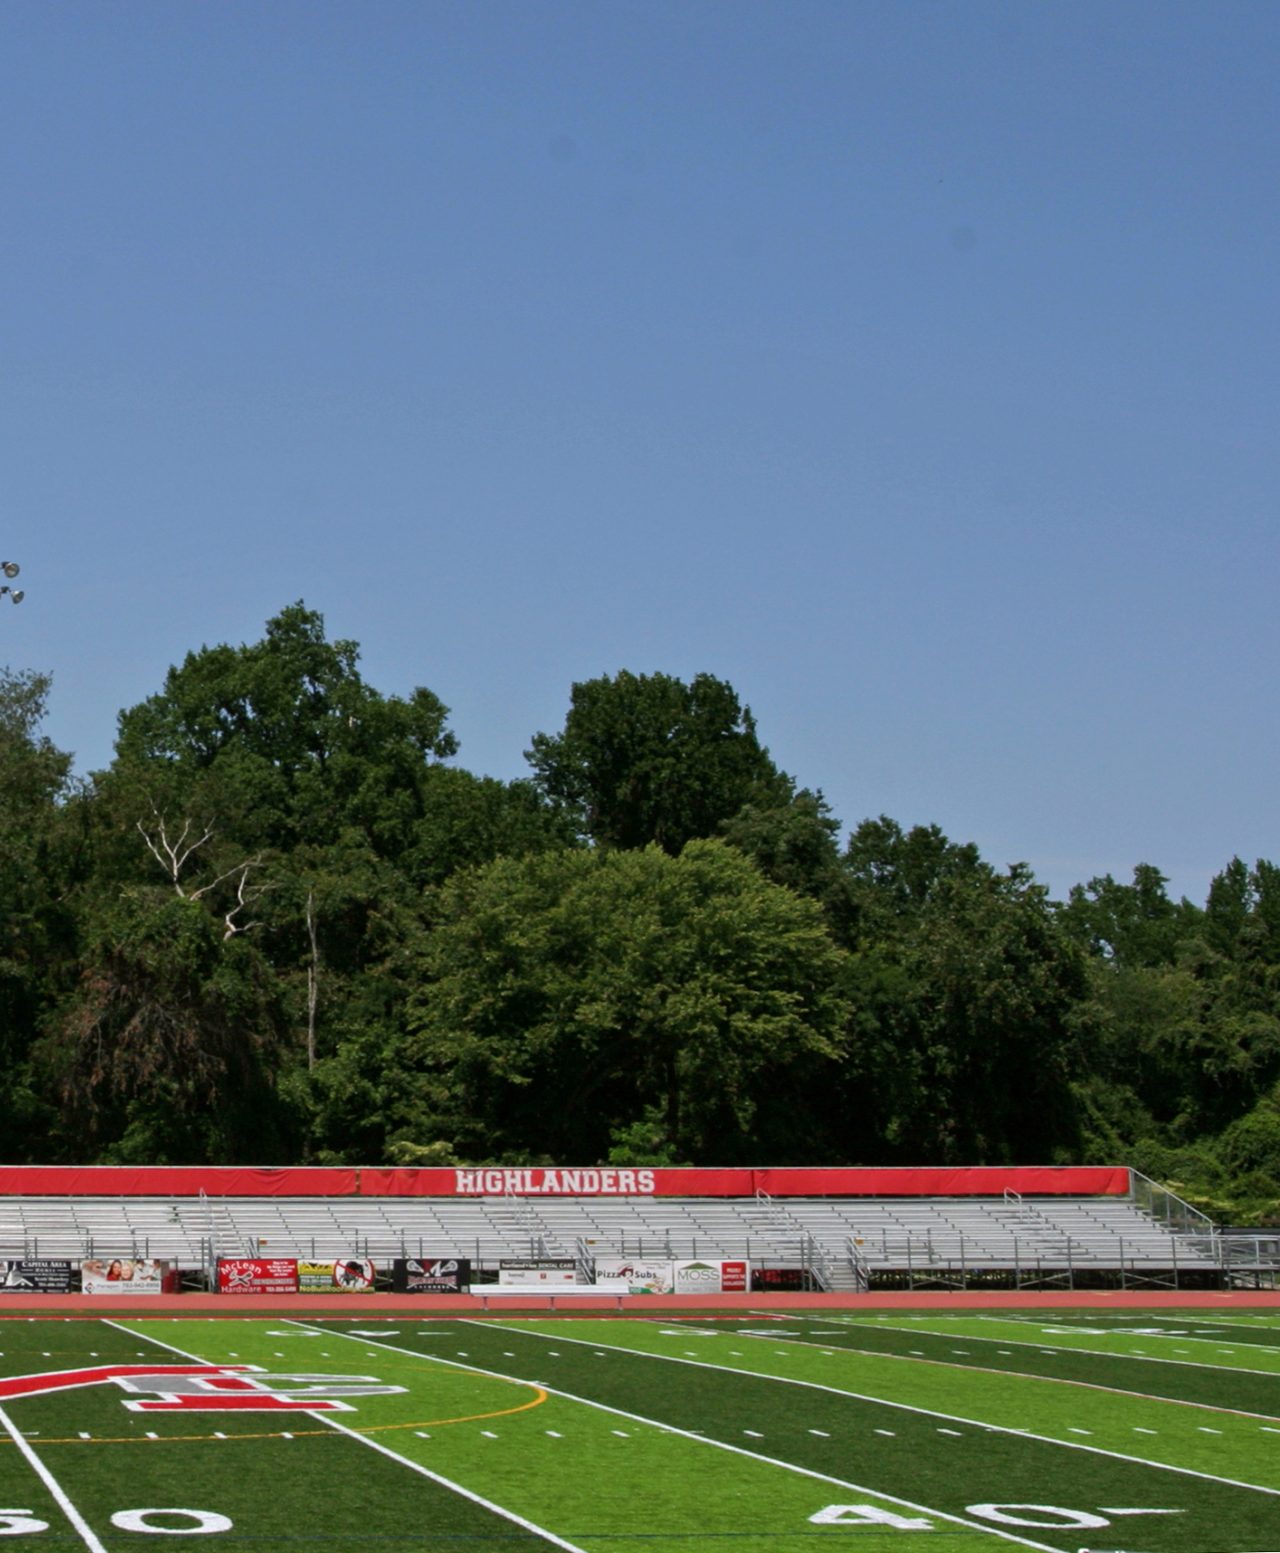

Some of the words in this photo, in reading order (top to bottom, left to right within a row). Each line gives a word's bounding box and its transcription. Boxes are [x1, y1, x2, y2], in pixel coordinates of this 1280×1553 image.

[455, 1170, 655, 1193] HIGHLANDERS
[221, 1260, 262, 1275] McLean
[634, 1270, 657, 1279] Subs
[677, 1269, 720, 1281] MOSS
